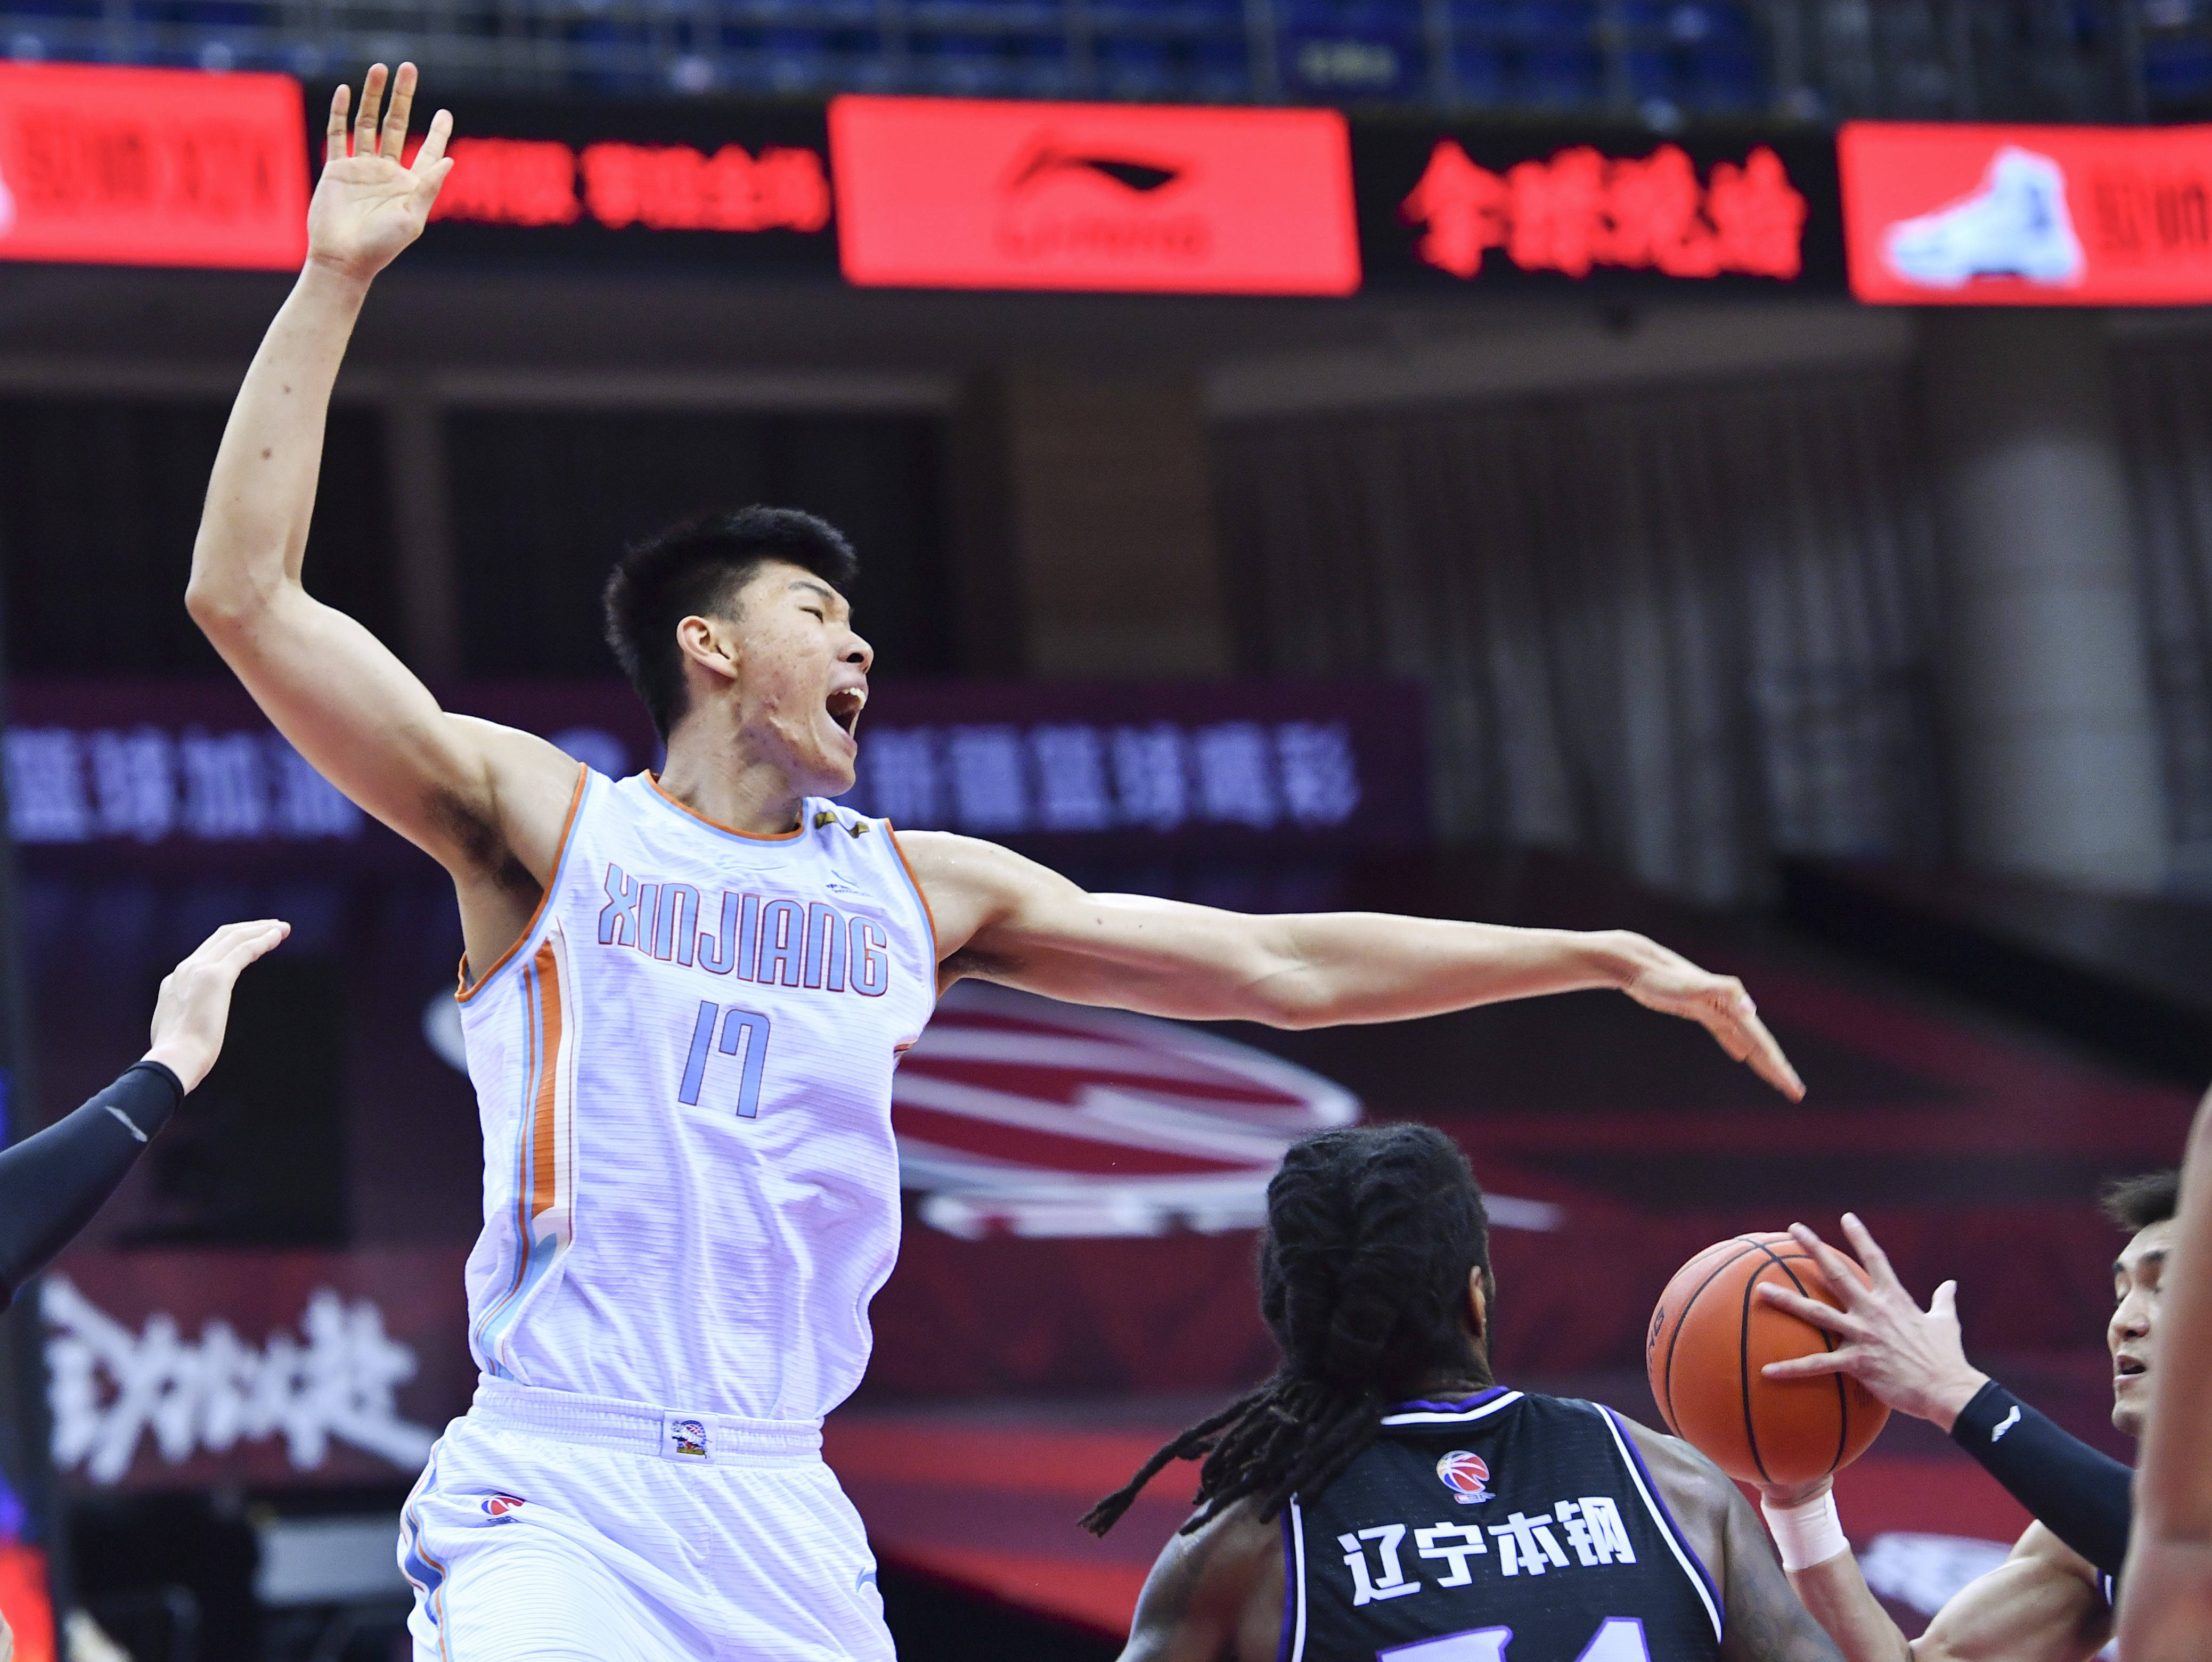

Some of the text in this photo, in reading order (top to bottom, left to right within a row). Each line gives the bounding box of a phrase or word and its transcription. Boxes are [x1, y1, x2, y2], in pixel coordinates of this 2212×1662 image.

[598, 862, 888, 997] XINJIANG
[678, 1000, 771, 1119] 17
[1337, 1496, 1637, 1607] 辽宁本钢
